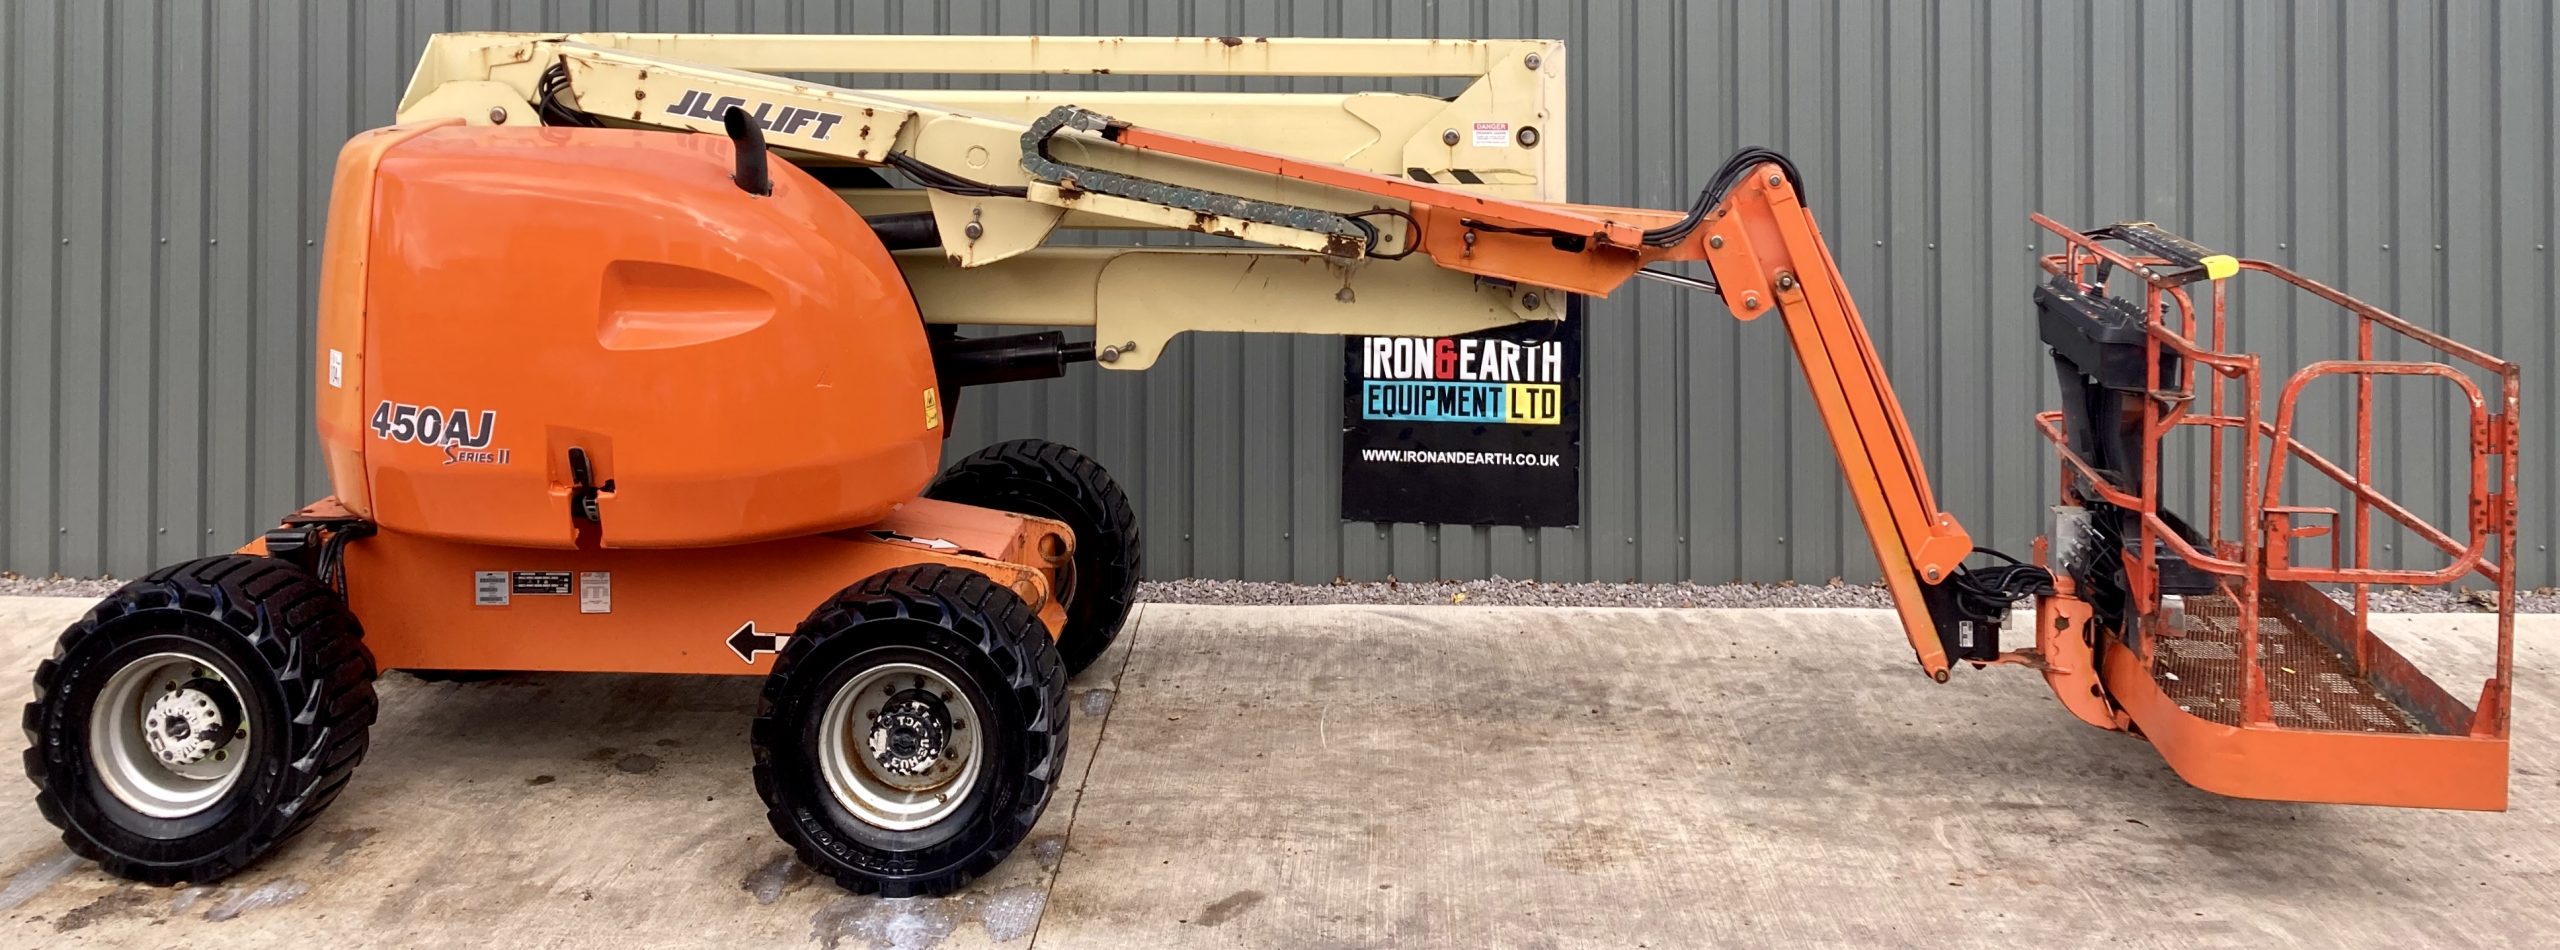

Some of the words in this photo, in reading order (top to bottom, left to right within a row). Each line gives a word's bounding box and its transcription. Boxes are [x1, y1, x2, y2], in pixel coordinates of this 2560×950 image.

[750, 102, 843, 140] LIFT
[1367, 384, 1503, 417] EQUIPMENT
[1511, 387, 1556, 419] LTD
[370, 400, 497, 450] 450AJ
[1361, 449, 1560, 467] WWW.IRONANDEARTH.CO.UK
